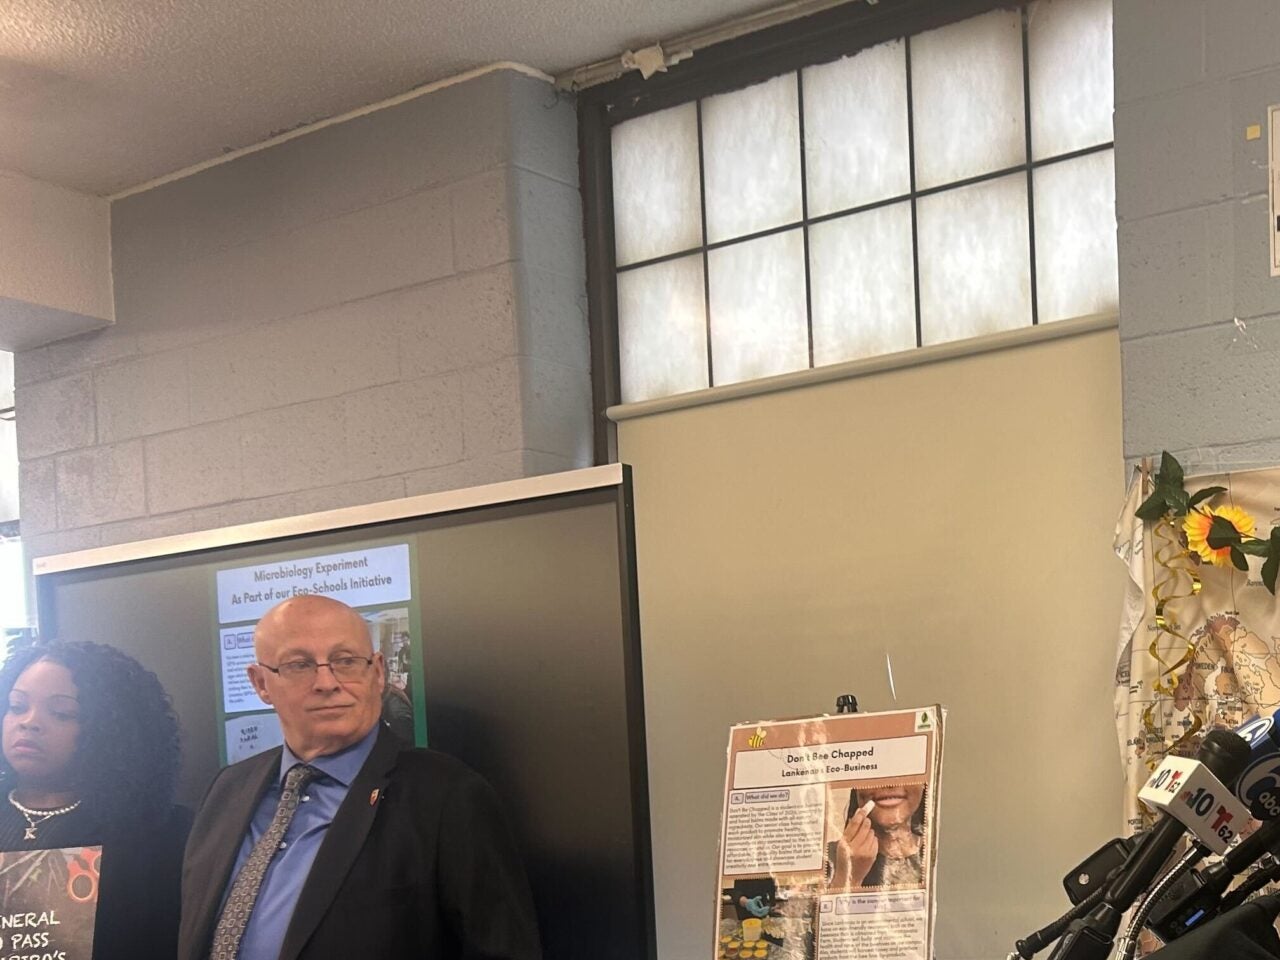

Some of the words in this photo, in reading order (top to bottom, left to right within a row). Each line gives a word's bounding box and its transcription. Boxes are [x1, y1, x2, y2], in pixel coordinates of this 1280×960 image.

[254, 564, 314, 583] Microbiology
[315, 556, 368, 576] Experiment
[231, 593, 242, 605] As
[243, 590, 263, 604] Part
[264, 587, 273, 600] of
[275, 588, 290, 599] our
[292, 577, 348, 598] Eco-Schools
[350, 574, 392, 589] Initiative
[812, 752, 828, 760] Bee
[831, 746, 874, 760] Chapped
[781, 768, 824, 777] Lankenaus
[826, 763, 877, 773] Eco-Business
[1259, 792, 1280, 816] abc
[1218, 825, 1233, 844] 62
[0, 910, 61, 928] NERAL
[11, 932, 49, 950] PASS
